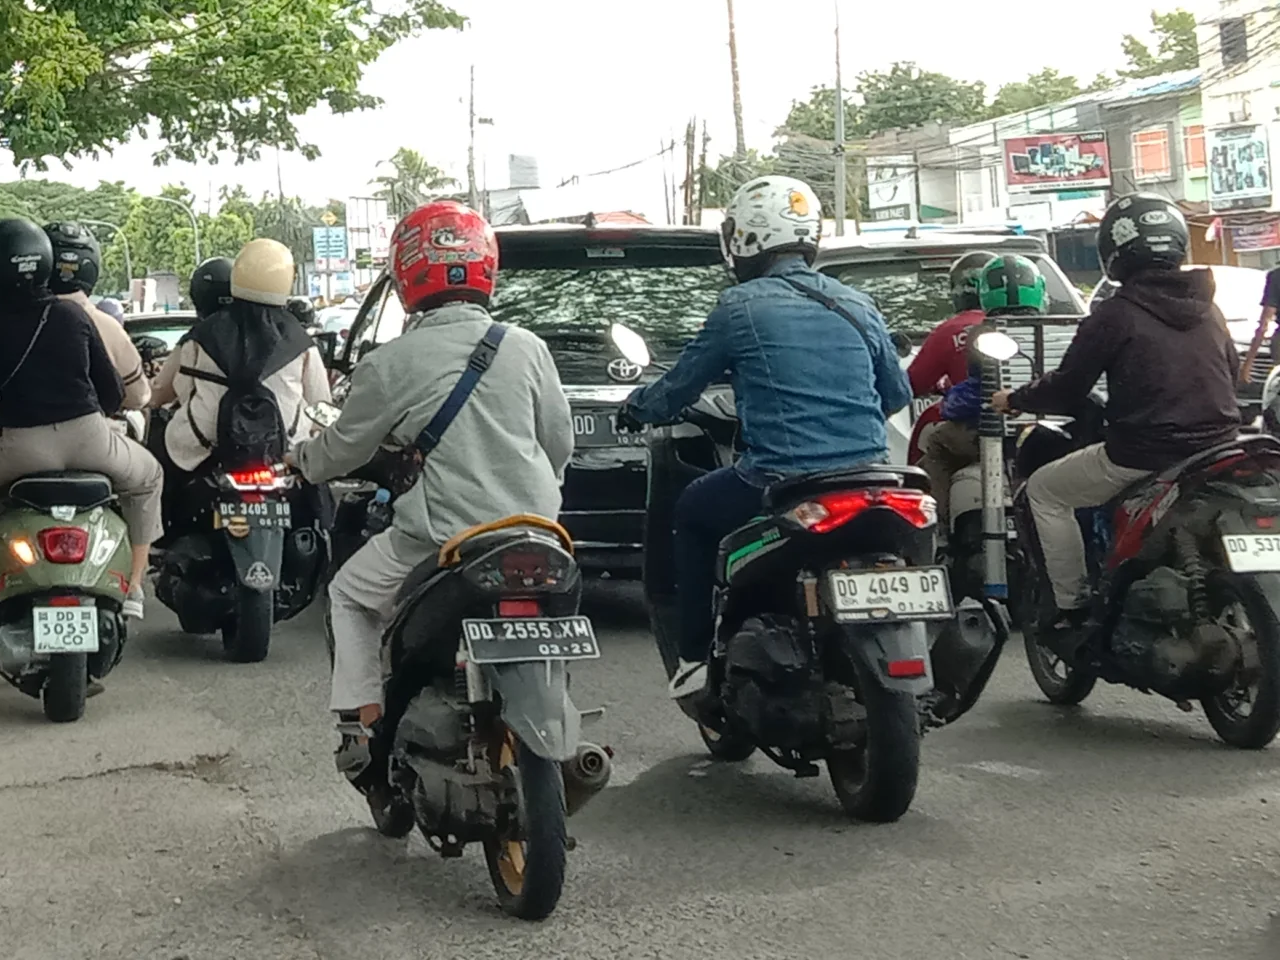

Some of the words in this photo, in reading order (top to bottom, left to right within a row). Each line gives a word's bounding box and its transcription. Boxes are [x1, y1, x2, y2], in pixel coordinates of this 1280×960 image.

[573, 415, 595, 435] DD
[1228, 538, 1247, 553] DD
[837, 579, 857, 596] DD
[869, 577, 909, 595] 4049
[920, 575, 939, 593] DP
[56, 611, 74, 621] DD
[43, 622, 89, 635] 3055
[467, 623, 493, 640] DD
[502, 622, 552, 639] 2555
[559, 620, 589, 638] XM
